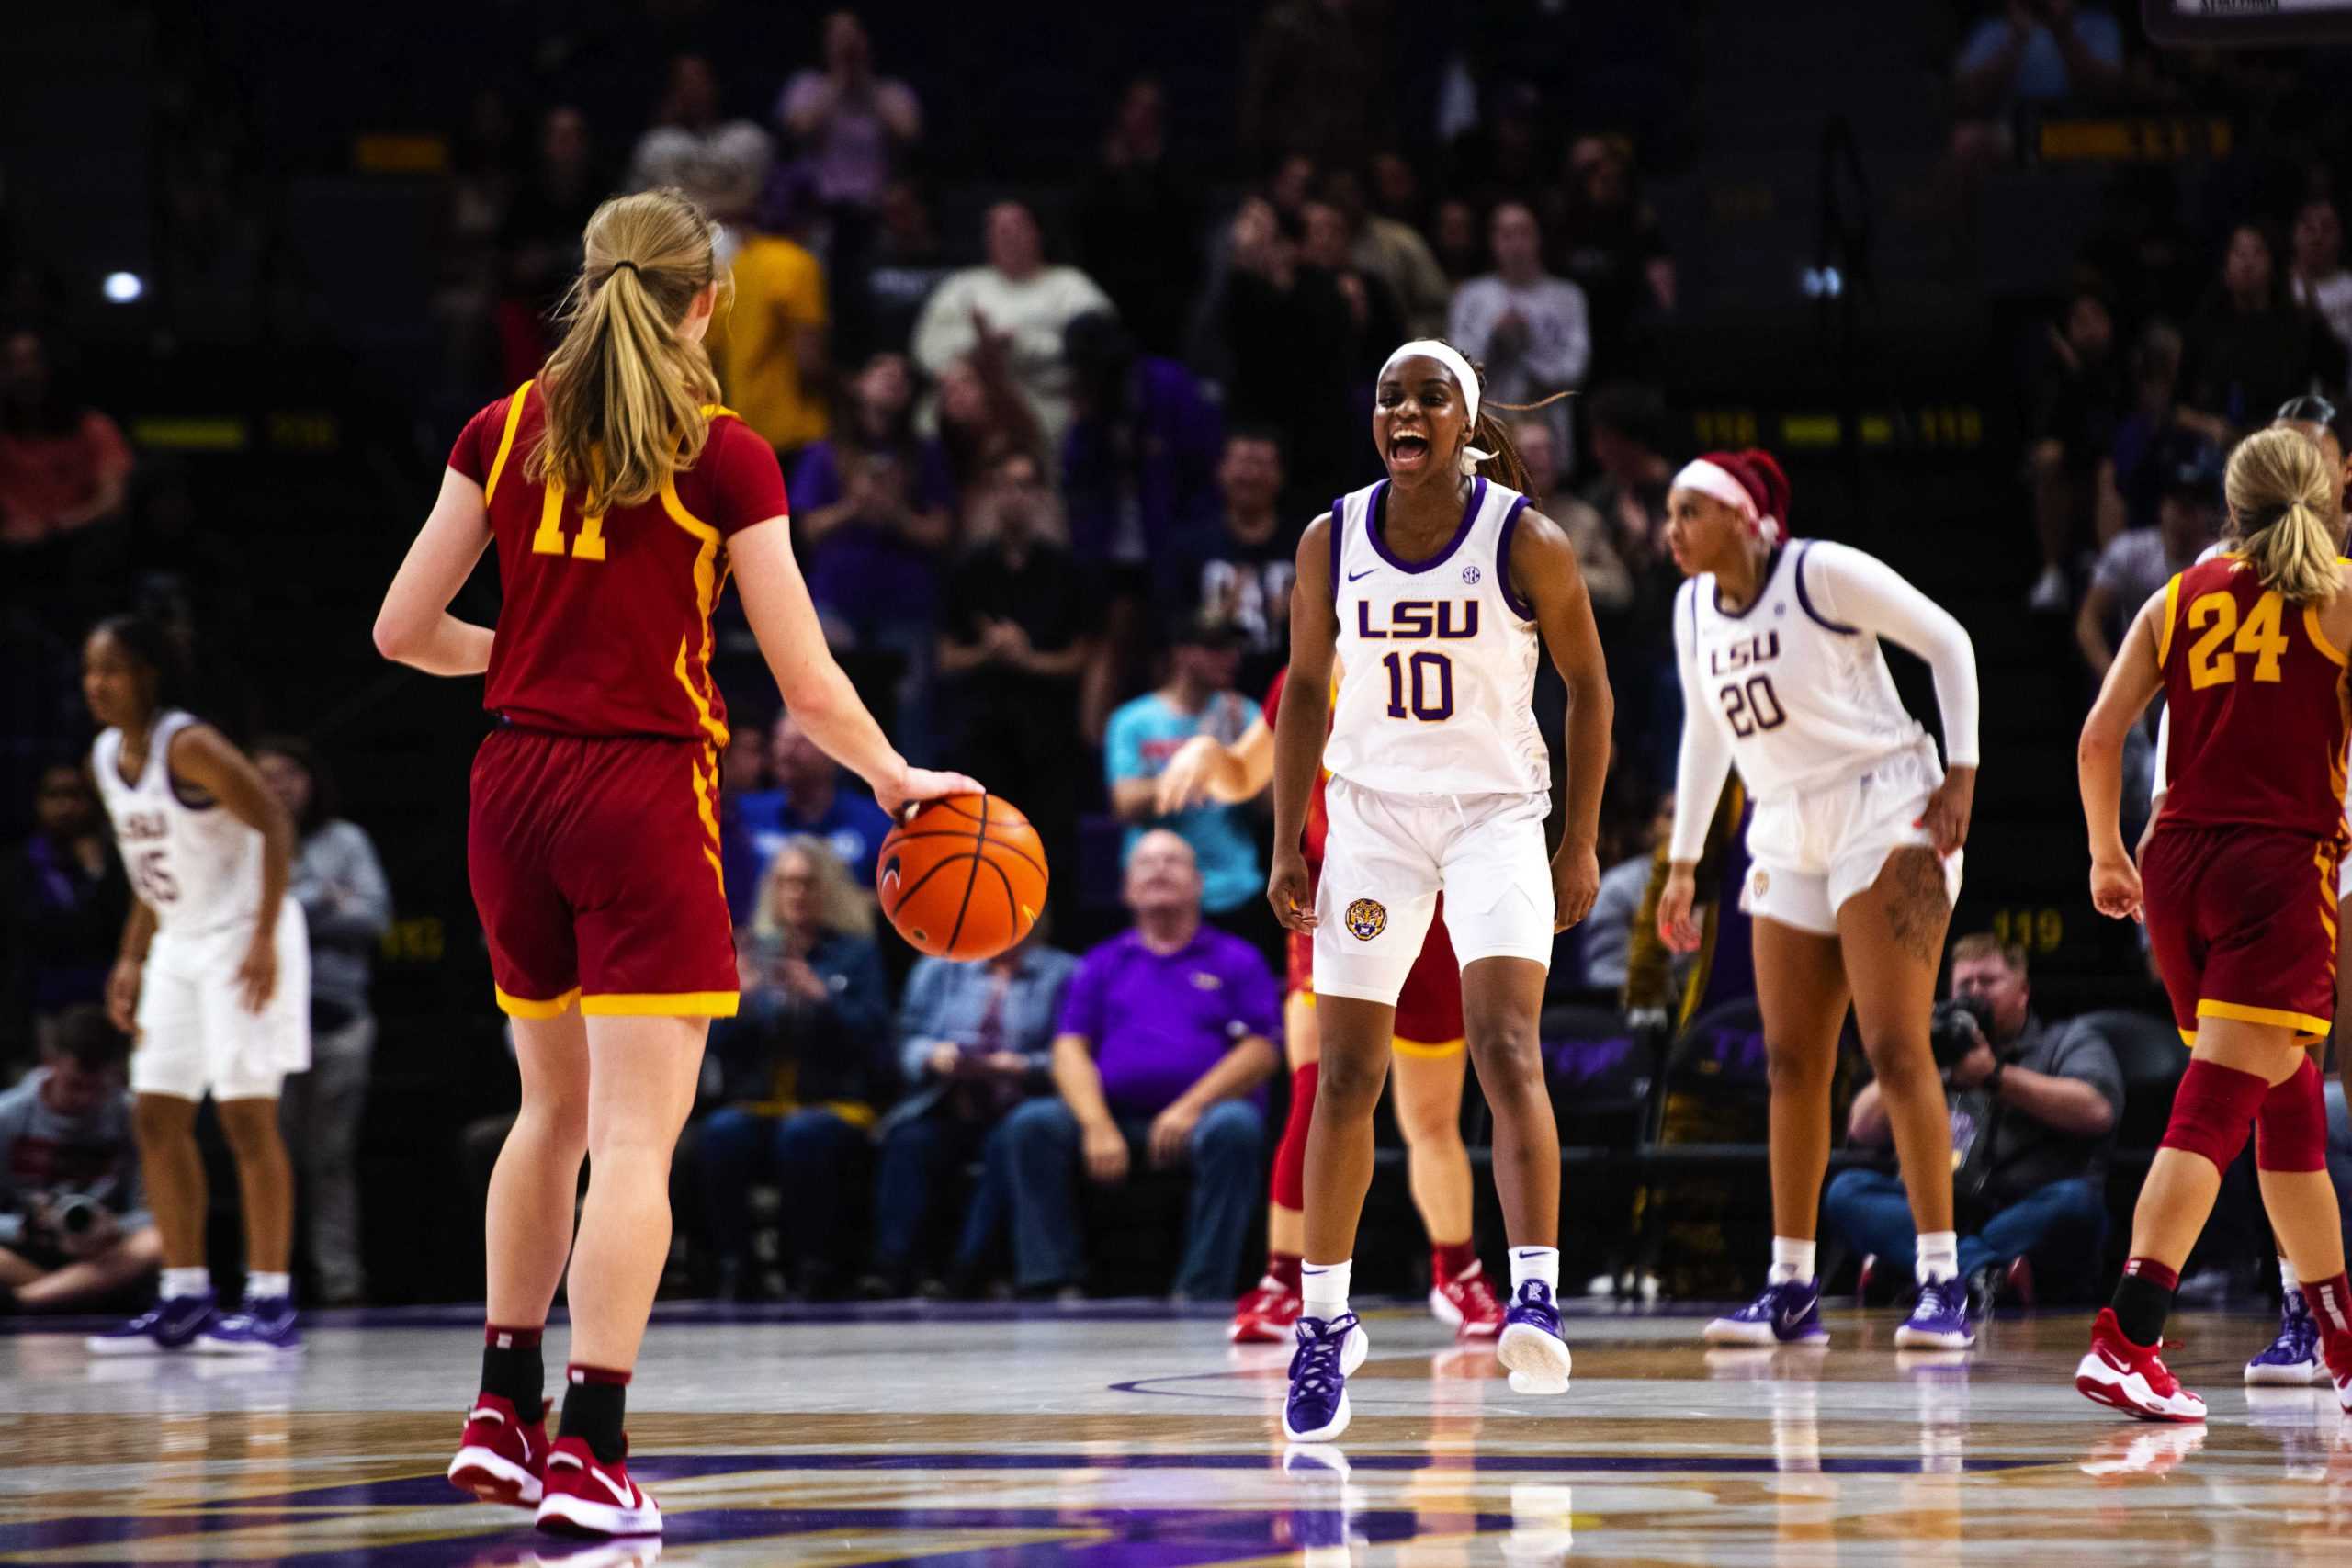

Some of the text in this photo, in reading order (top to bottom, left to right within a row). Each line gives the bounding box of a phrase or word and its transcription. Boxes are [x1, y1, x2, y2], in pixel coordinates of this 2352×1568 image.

[1357, 599, 1479, 639] LSU
[2188, 590, 2289, 691] 24
[1382, 650, 1454, 722] 10
[1711, 629, 1779, 677] LSU
[1720, 673, 1788, 739] 20
